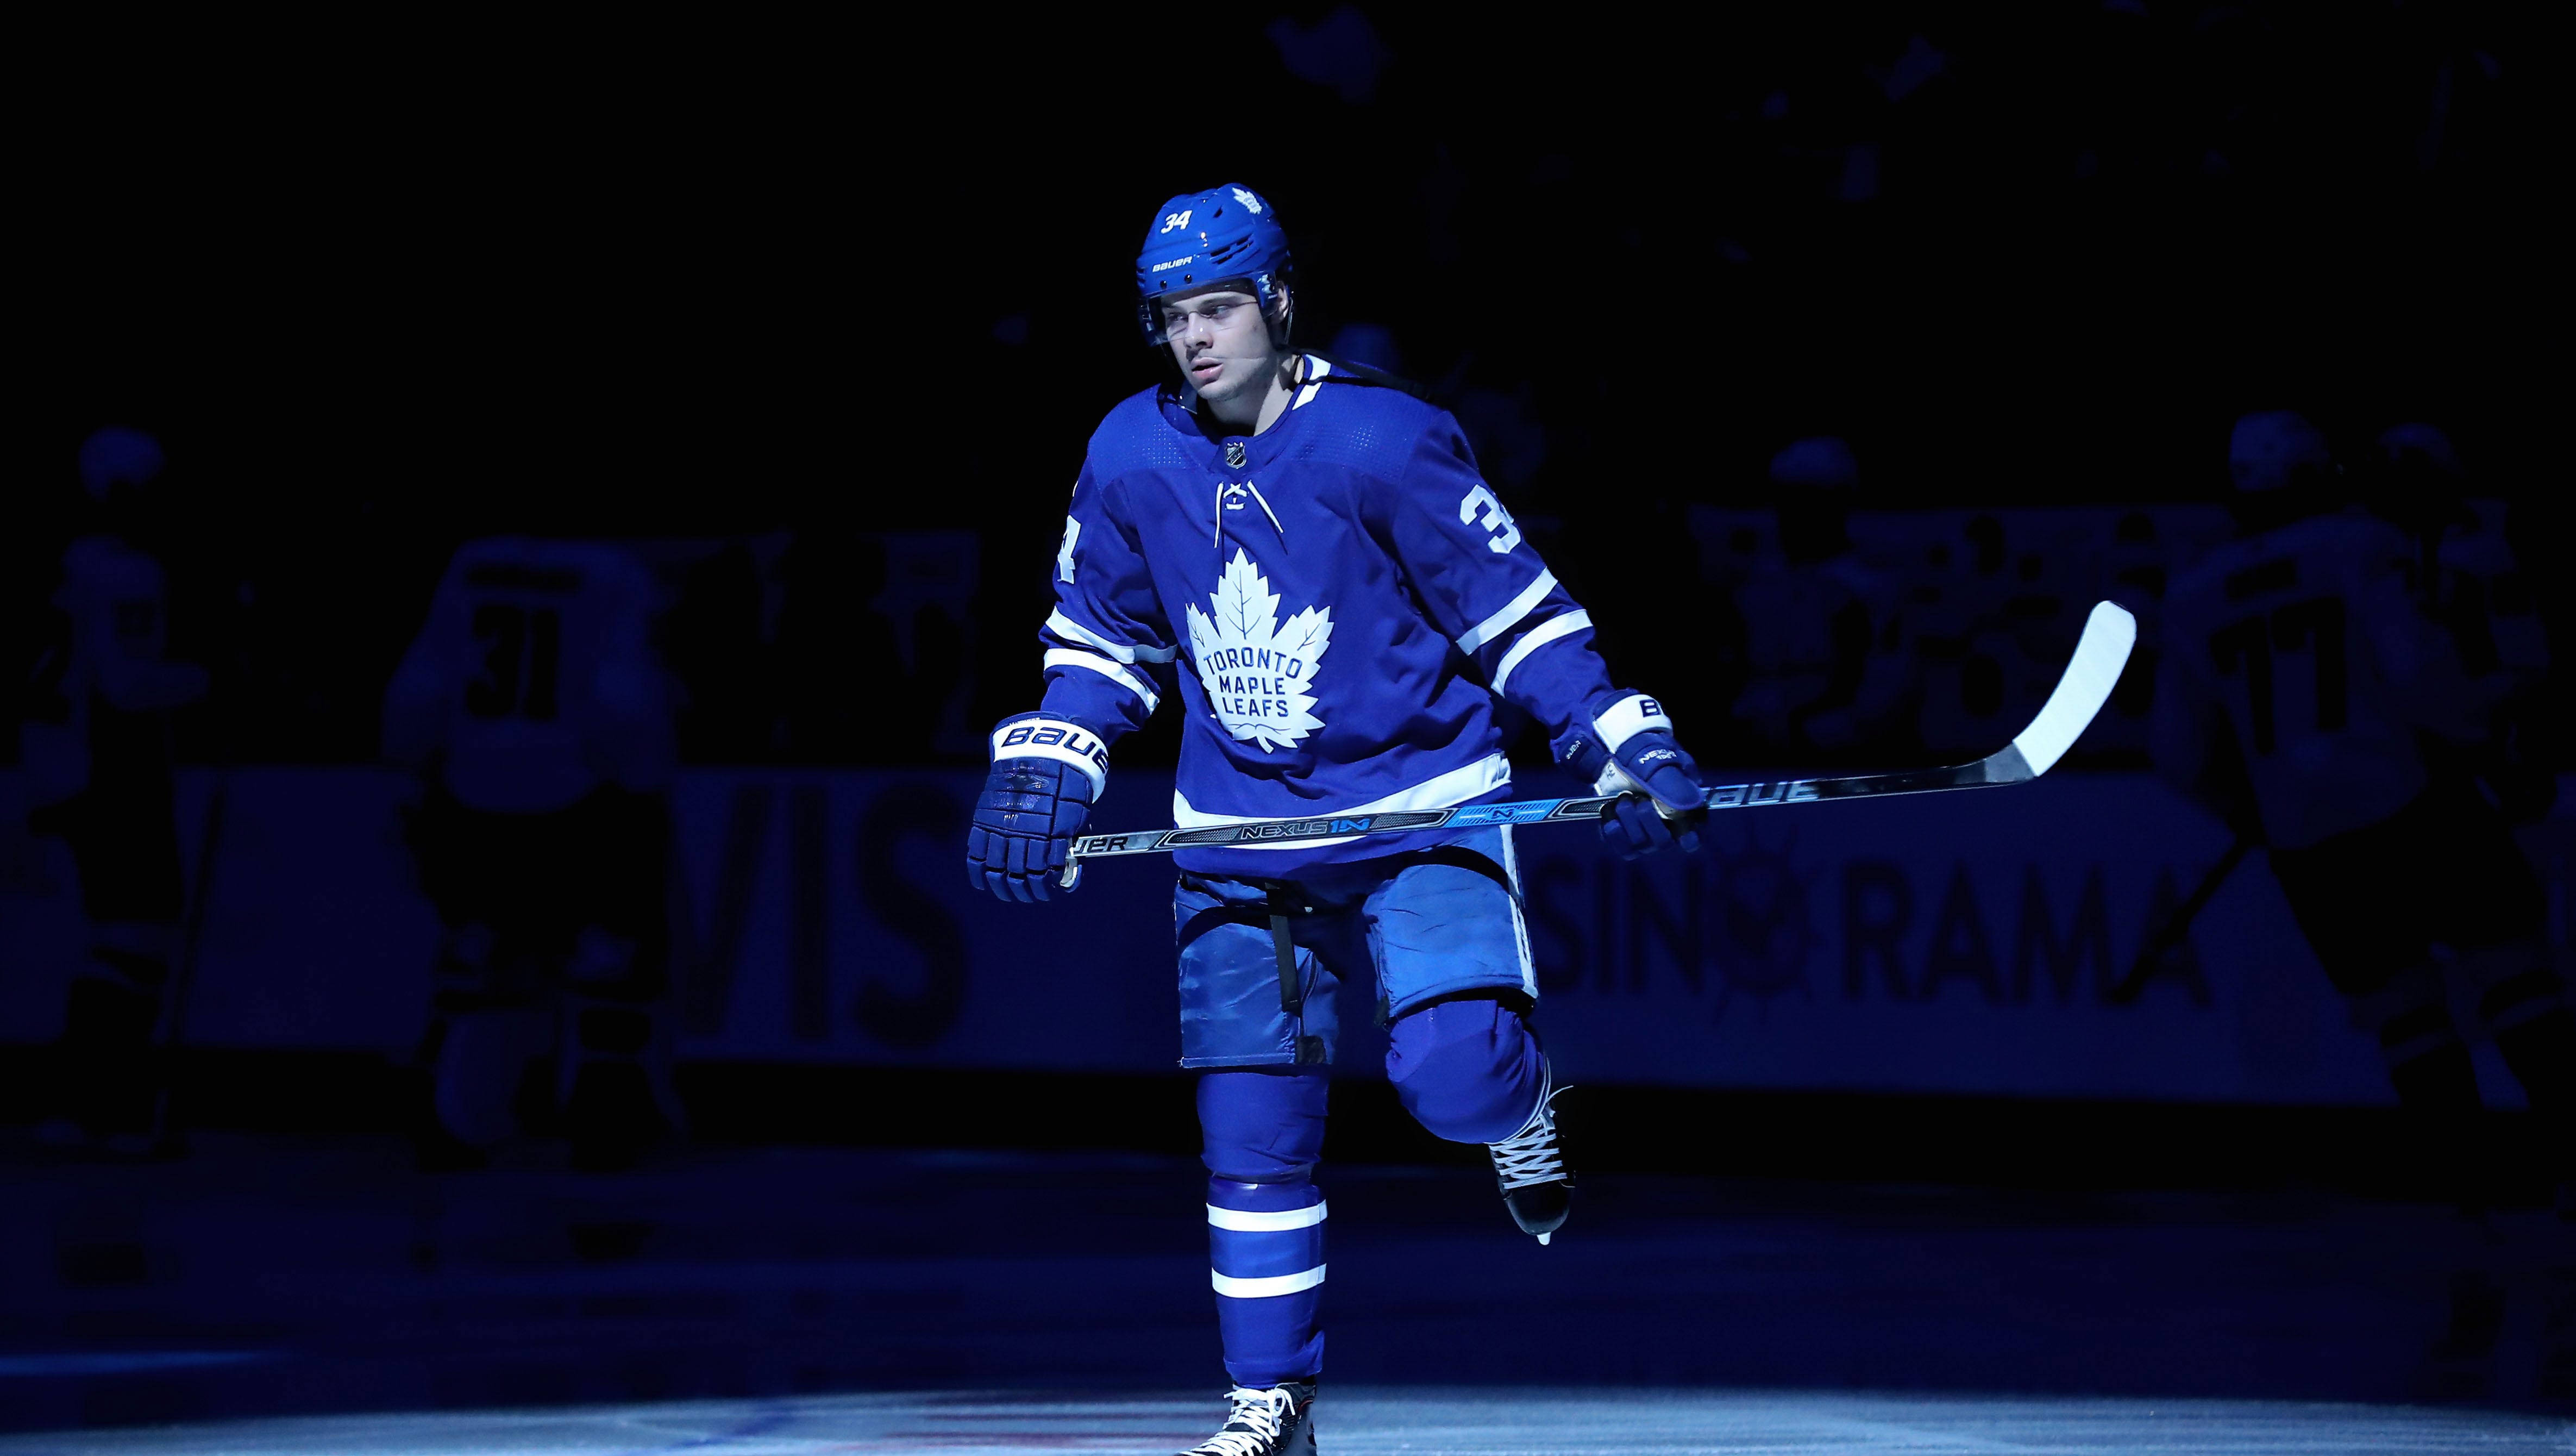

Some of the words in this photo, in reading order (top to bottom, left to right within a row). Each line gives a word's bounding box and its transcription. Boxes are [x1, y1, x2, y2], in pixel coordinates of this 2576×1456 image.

[1161, 210, 1192, 234] 34
[1152, 255, 1193, 272] BAUER
[466, 604, 559, 720] 31
[1204, 647, 1302, 679] TORONTO
[1219, 676, 1286, 695] MAPLE
[2209, 596, 2346, 755] 77
[1222, 697, 1288, 717] LEAFS
[1240, 821, 1329, 840] NEXUS
